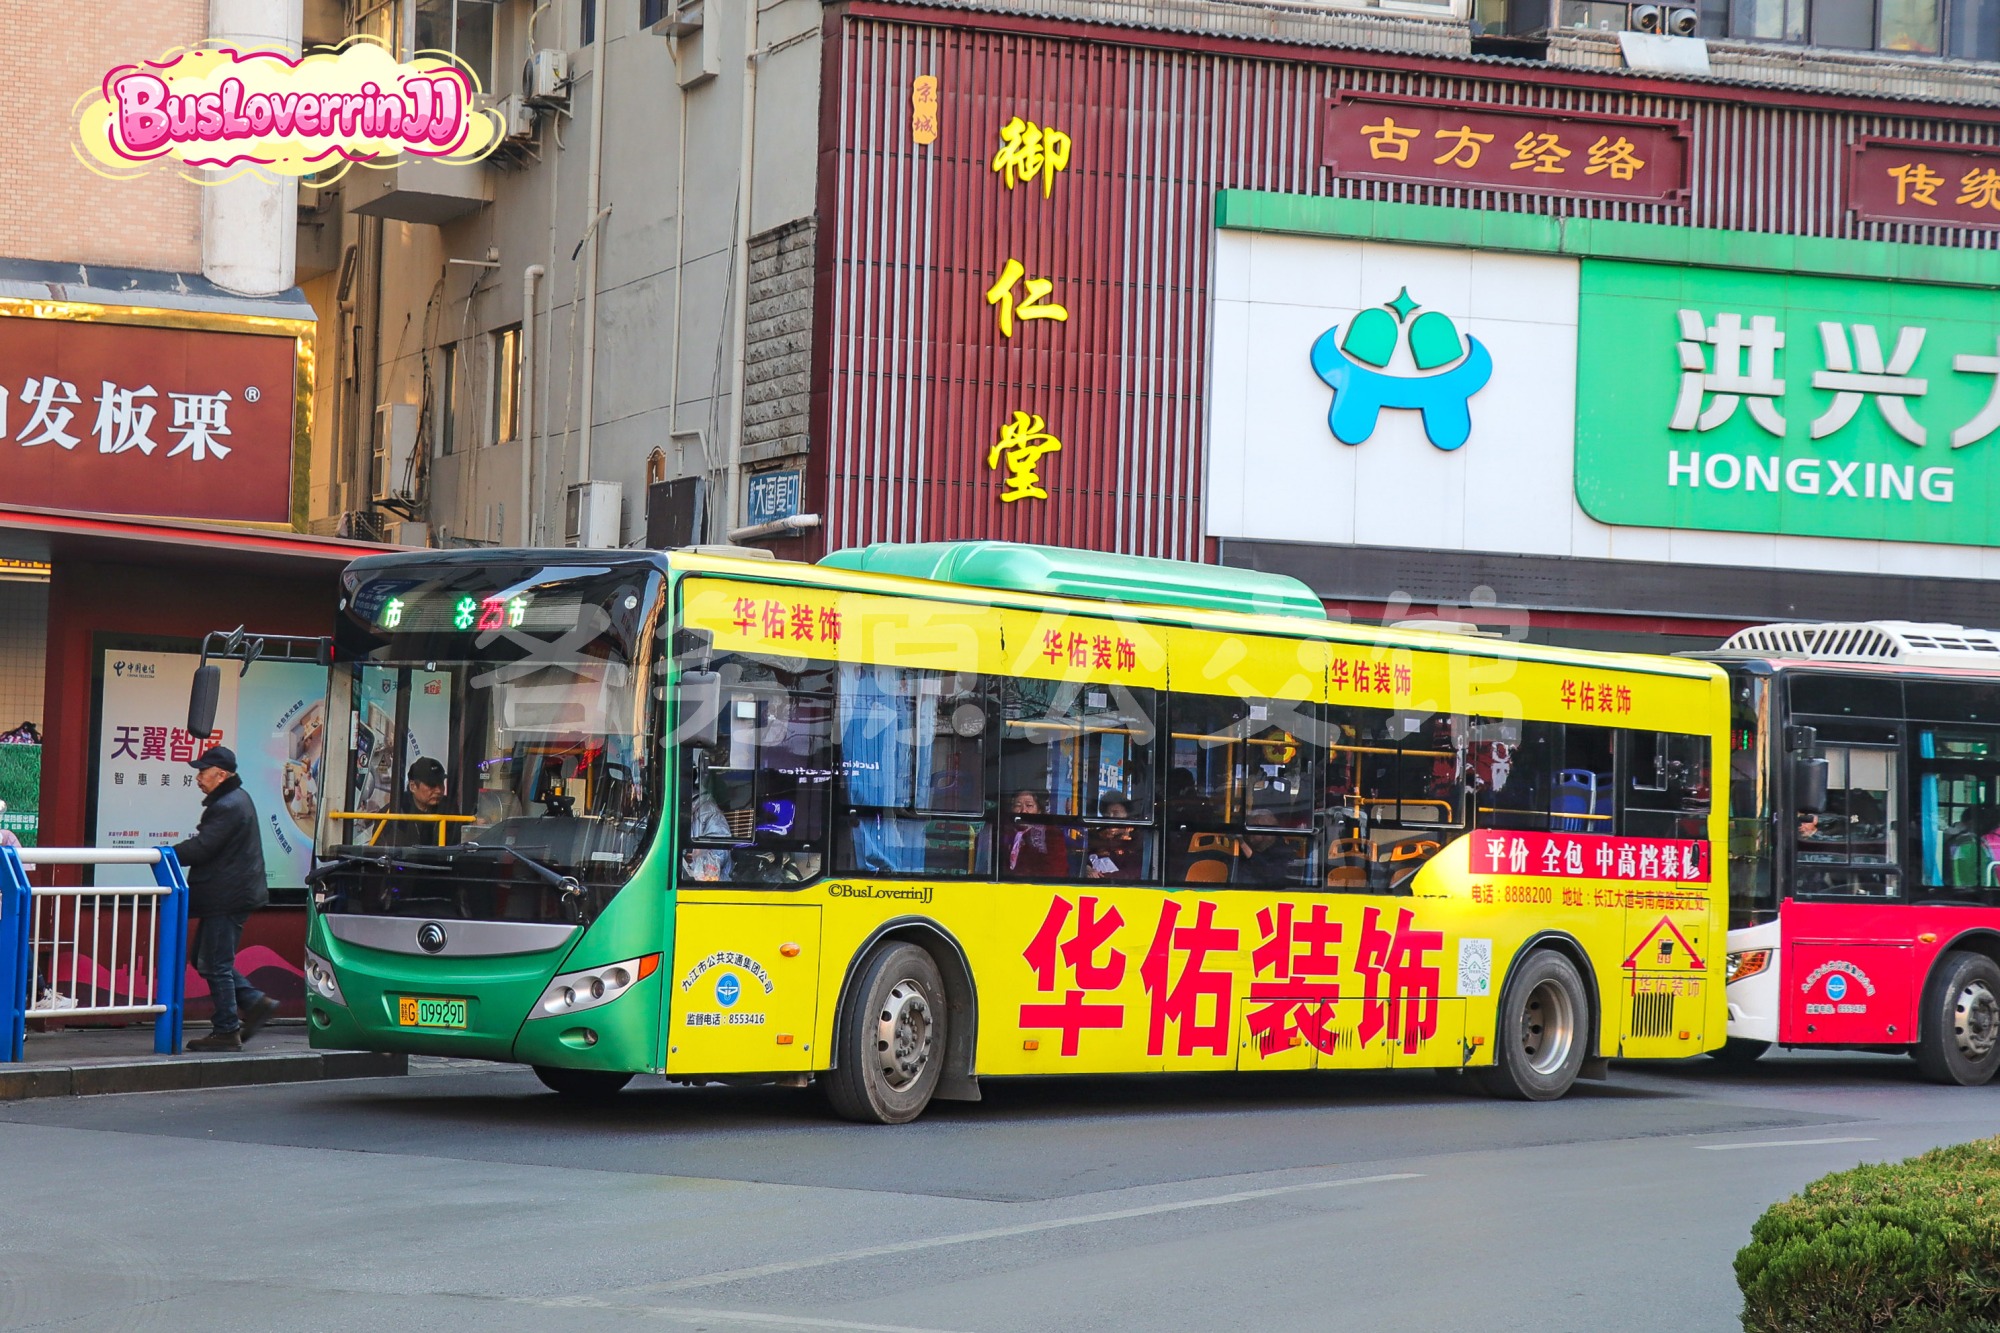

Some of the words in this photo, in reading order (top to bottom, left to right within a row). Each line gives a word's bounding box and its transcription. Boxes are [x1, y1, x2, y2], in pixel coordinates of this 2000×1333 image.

[1359, 116, 1646, 181] 古方经络
[986, 115, 1071, 502] 御仁堂
[0, 376, 232, 460] 发板栗
[1668, 450, 1955, 502] HONGXING
[733, 597, 842, 642] 华佑装饰
[1042, 629, 1136, 672] 华佑装饰
[1332, 658, 1412, 696] 华佑装饰
[1561, 678, 1631, 715] 华佑装饰
[1485, 837, 1529, 872] 平价
[1541, 839, 1584, 874] 全包
[682, 951, 774, 994] 九江市公共交通集团公司
[1019, 894, 1443, 1055] 华佑装饰
